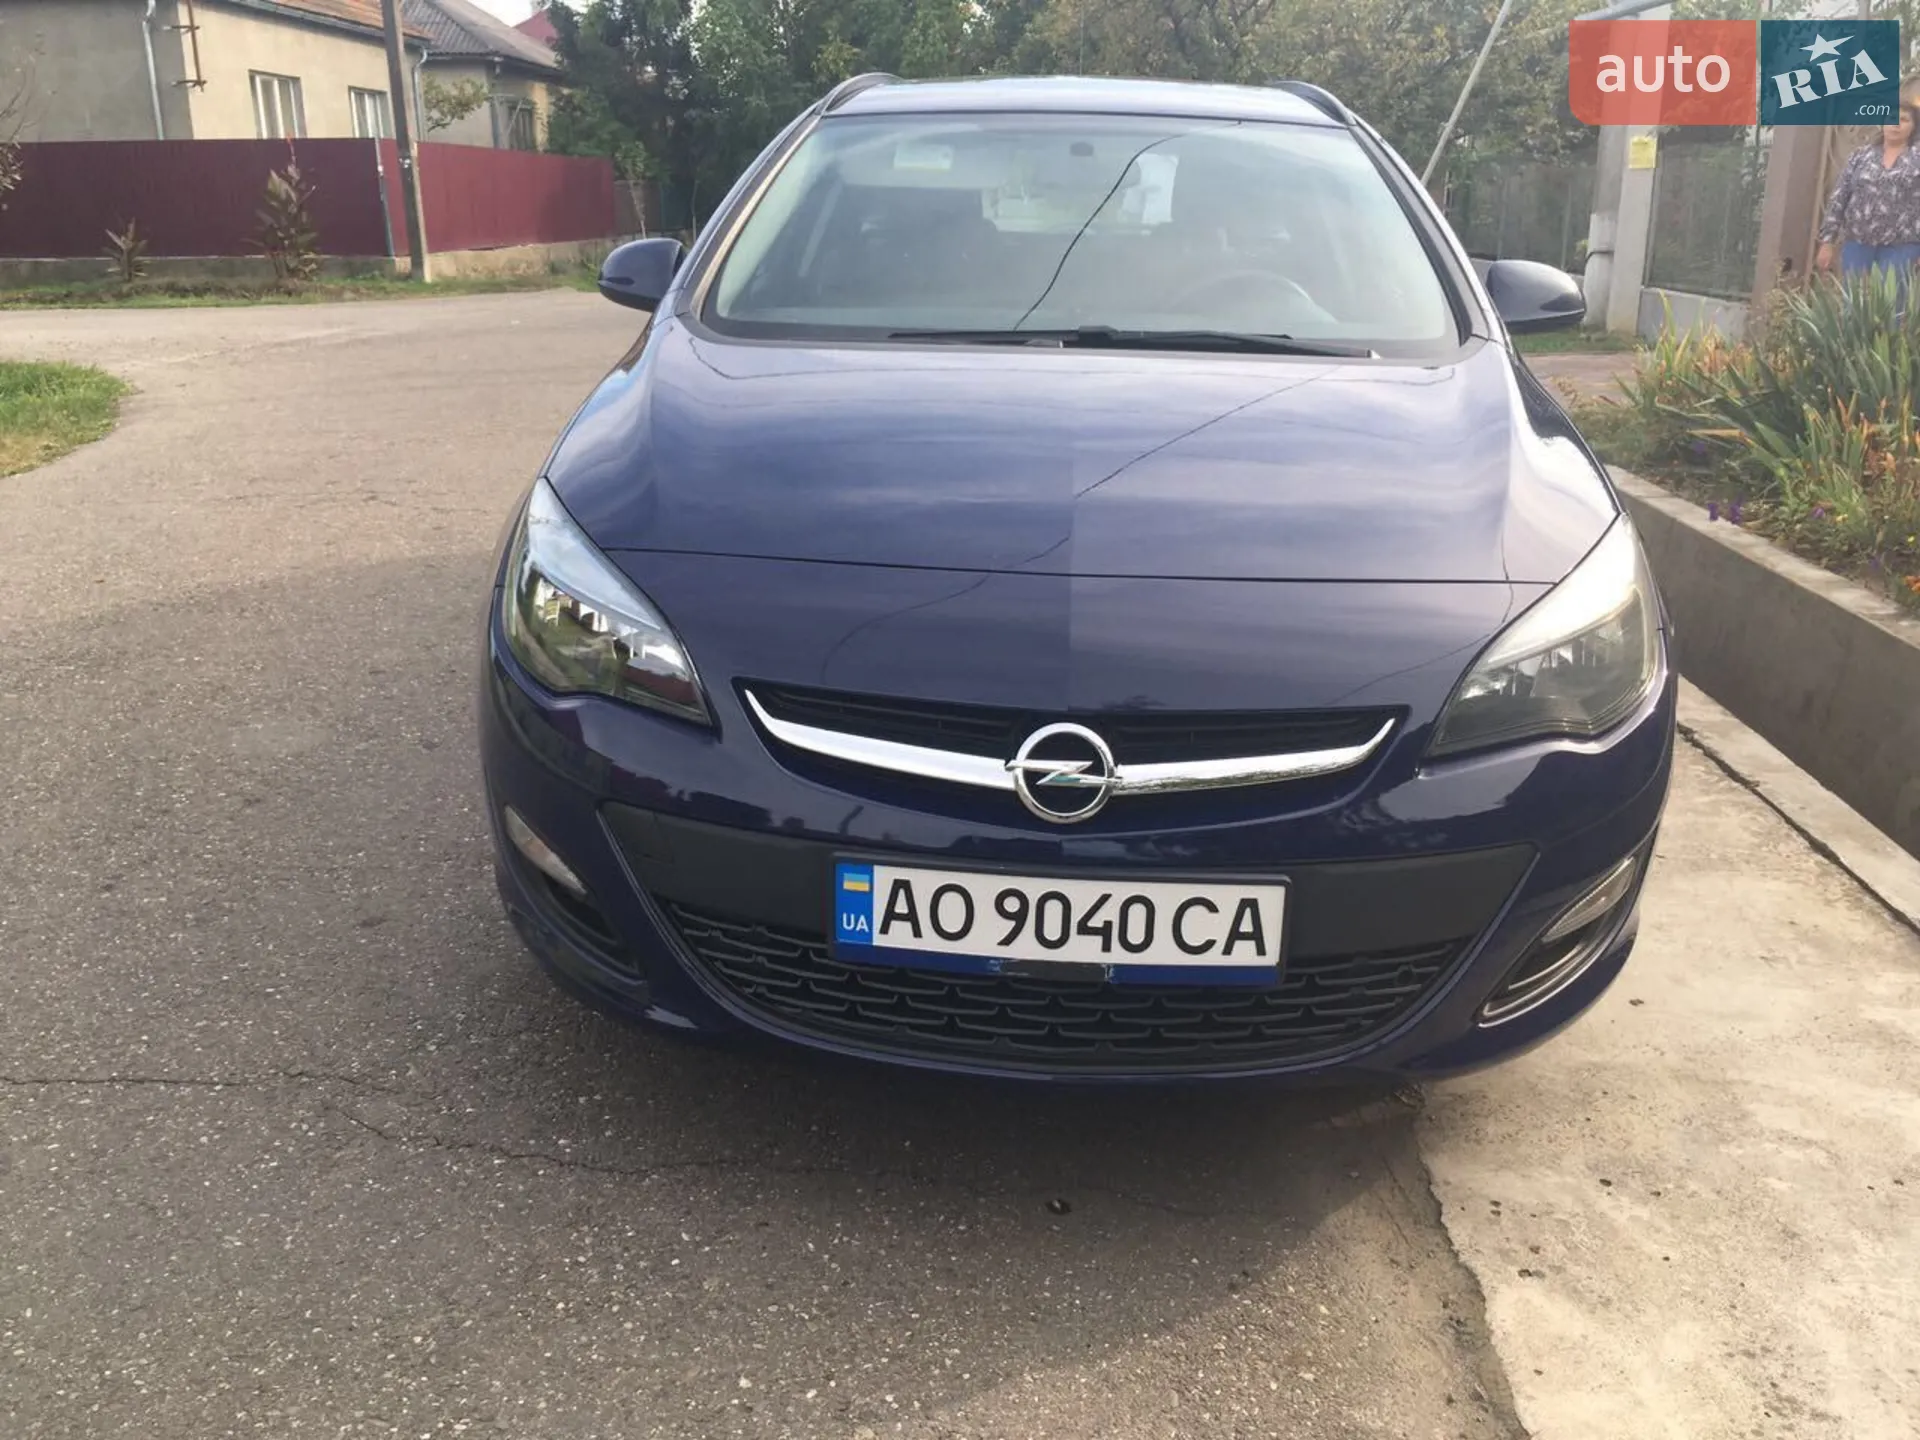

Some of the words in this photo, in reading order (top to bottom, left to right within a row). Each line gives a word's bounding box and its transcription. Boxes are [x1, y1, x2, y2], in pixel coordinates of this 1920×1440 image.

[842, 913, 870, 933] UA
[878, 878, 975, 942] AO
[994, 887, 1156, 954] 9040
[1172, 896, 1267, 956] CA
